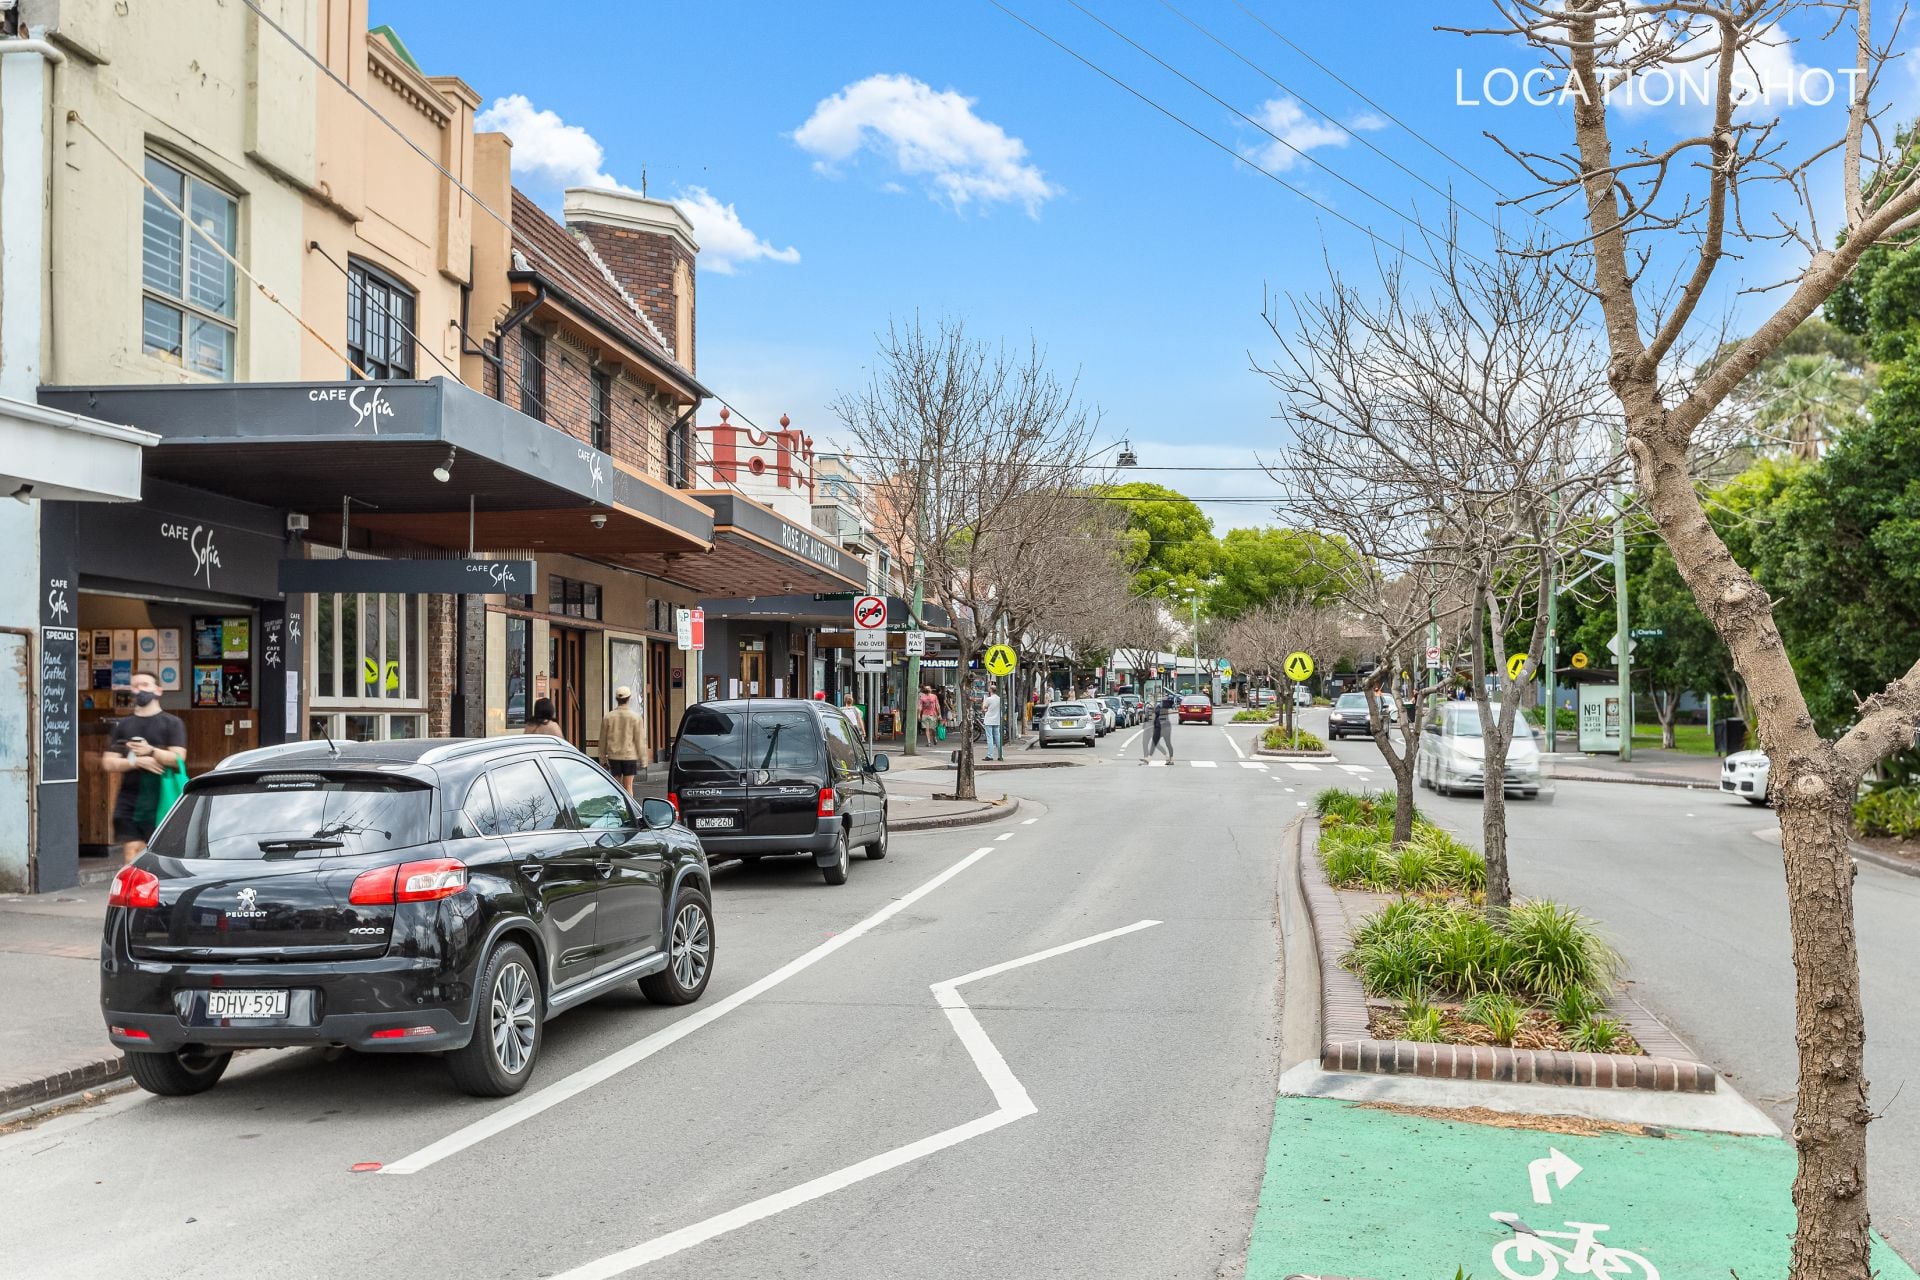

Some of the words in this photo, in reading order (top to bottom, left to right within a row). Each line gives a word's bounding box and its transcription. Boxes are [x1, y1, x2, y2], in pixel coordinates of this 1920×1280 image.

[309, 390, 346, 401] CAFE
[349, 386, 394, 435] Sofia
[578, 448, 590, 462] CAFE
[782, 523, 799, 552] ROSE
[800, 533, 809, 557] OF
[810, 538, 840, 571] AUSTRALIA
[161, 522, 189, 541] CAFE
[191, 525, 222, 589] Sofia
[51, 578, 68, 589] CAFE
[466, 564, 488, 572] CAFE
[489, 563, 517, 592] Sofia
[49, 589, 69, 625] Sofia
[46, 630, 75, 641] SPECIALS
[44, 651, 62, 665] Hand
[44, 698, 59, 713] Pies
[44, 715, 70, 734] Sausage
[45, 731, 63, 745] Rolls
[349, 927, 385, 935] 4008
